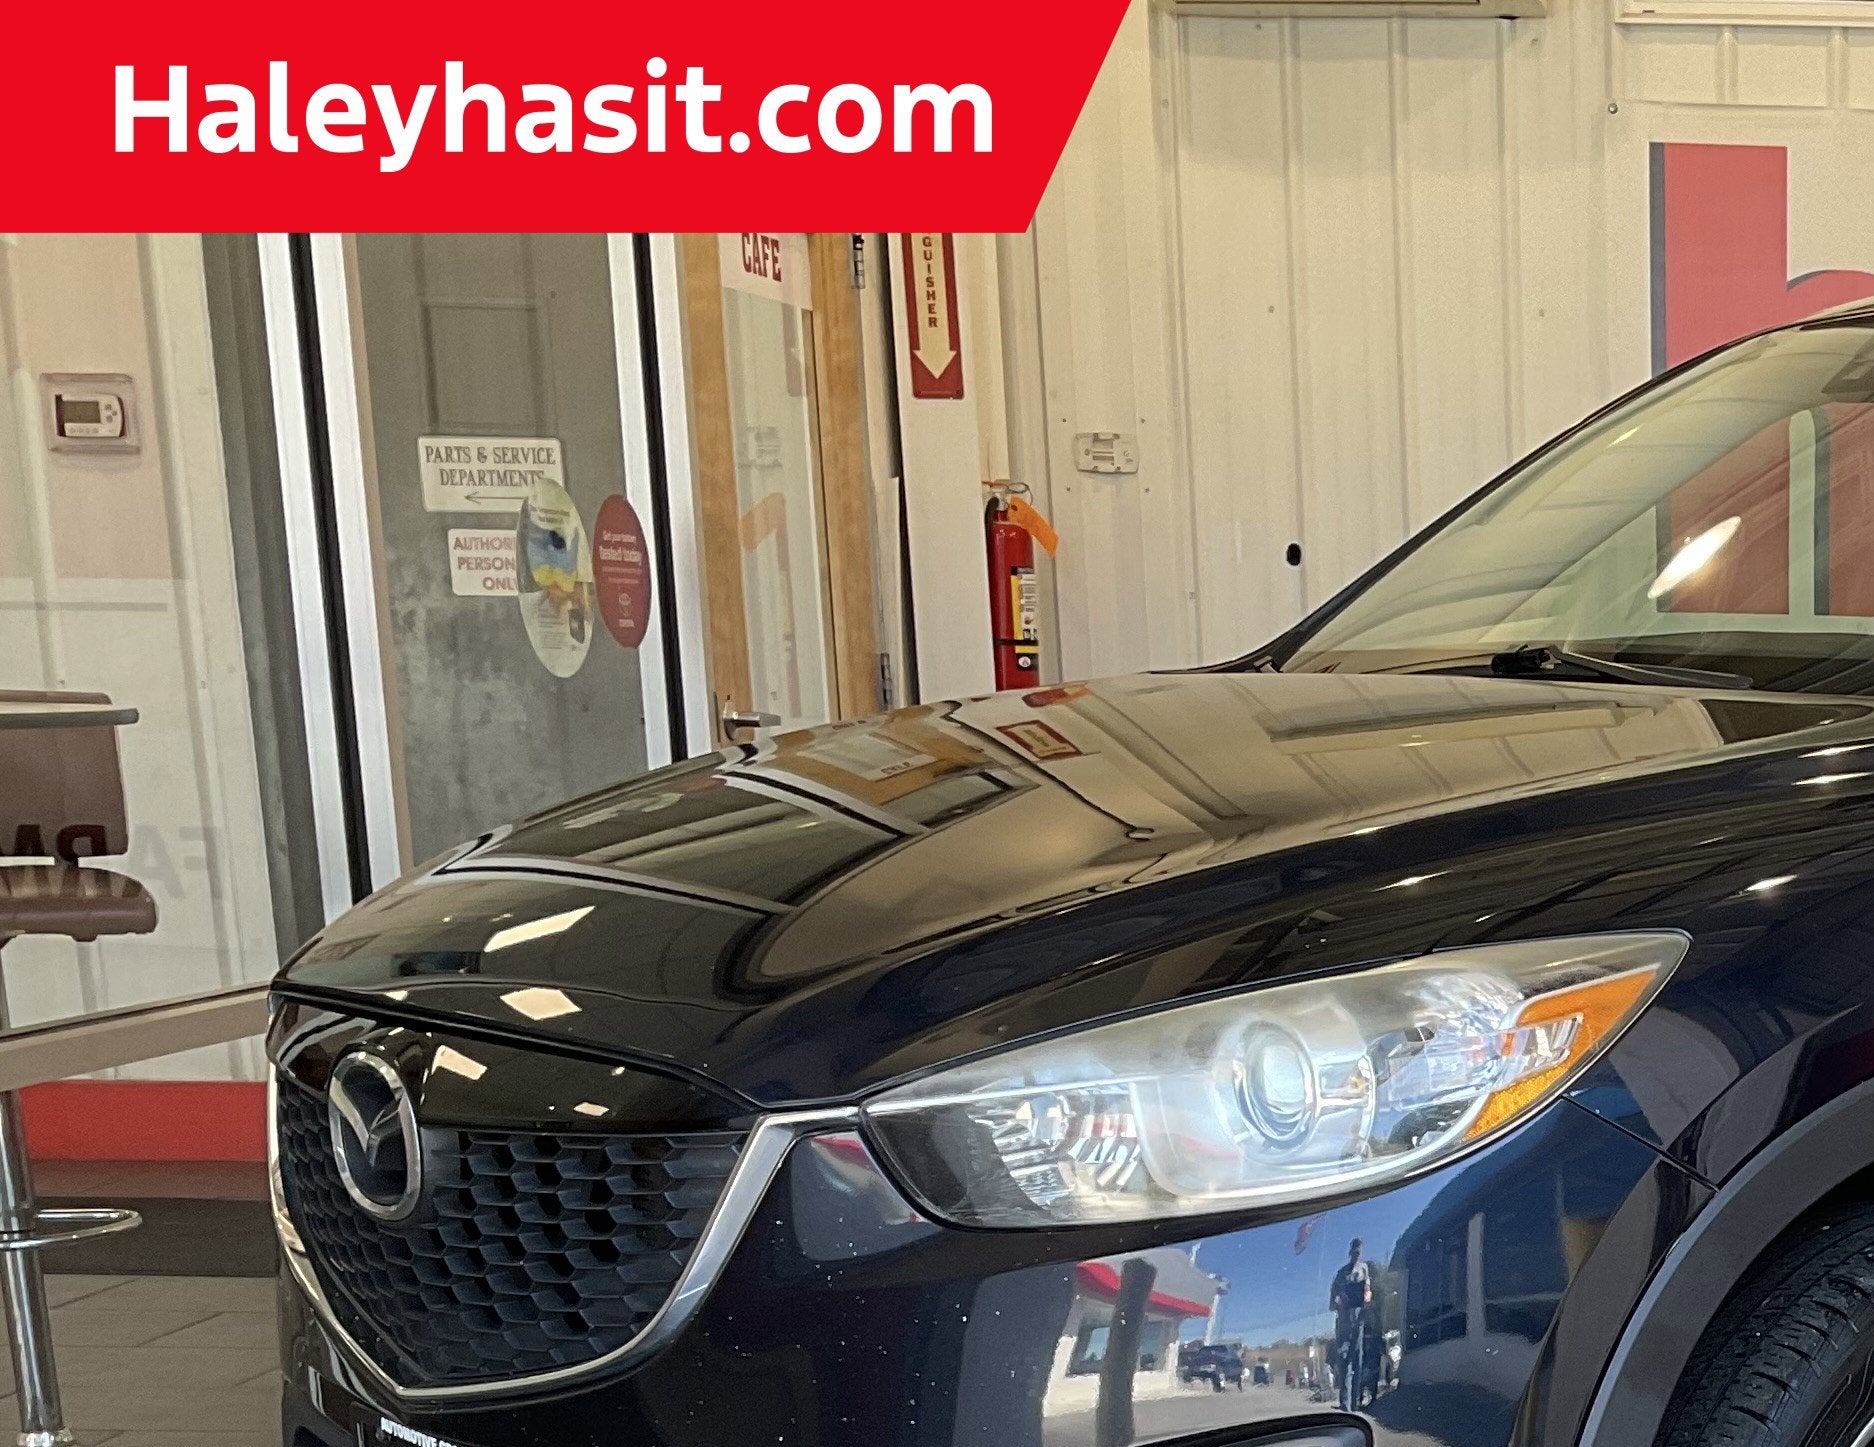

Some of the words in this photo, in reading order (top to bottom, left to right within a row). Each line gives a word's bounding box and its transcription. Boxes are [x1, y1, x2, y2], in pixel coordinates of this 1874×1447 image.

[741, 233, 782, 282] CAFE
[921, 233, 939, 329] GUISHER
[425, 445, 472, 464] PARTS
[476, 447, 488, 464] &
[493, 447, 556, 465] SERVICE
[457, 556, 516, 571] PERSON
